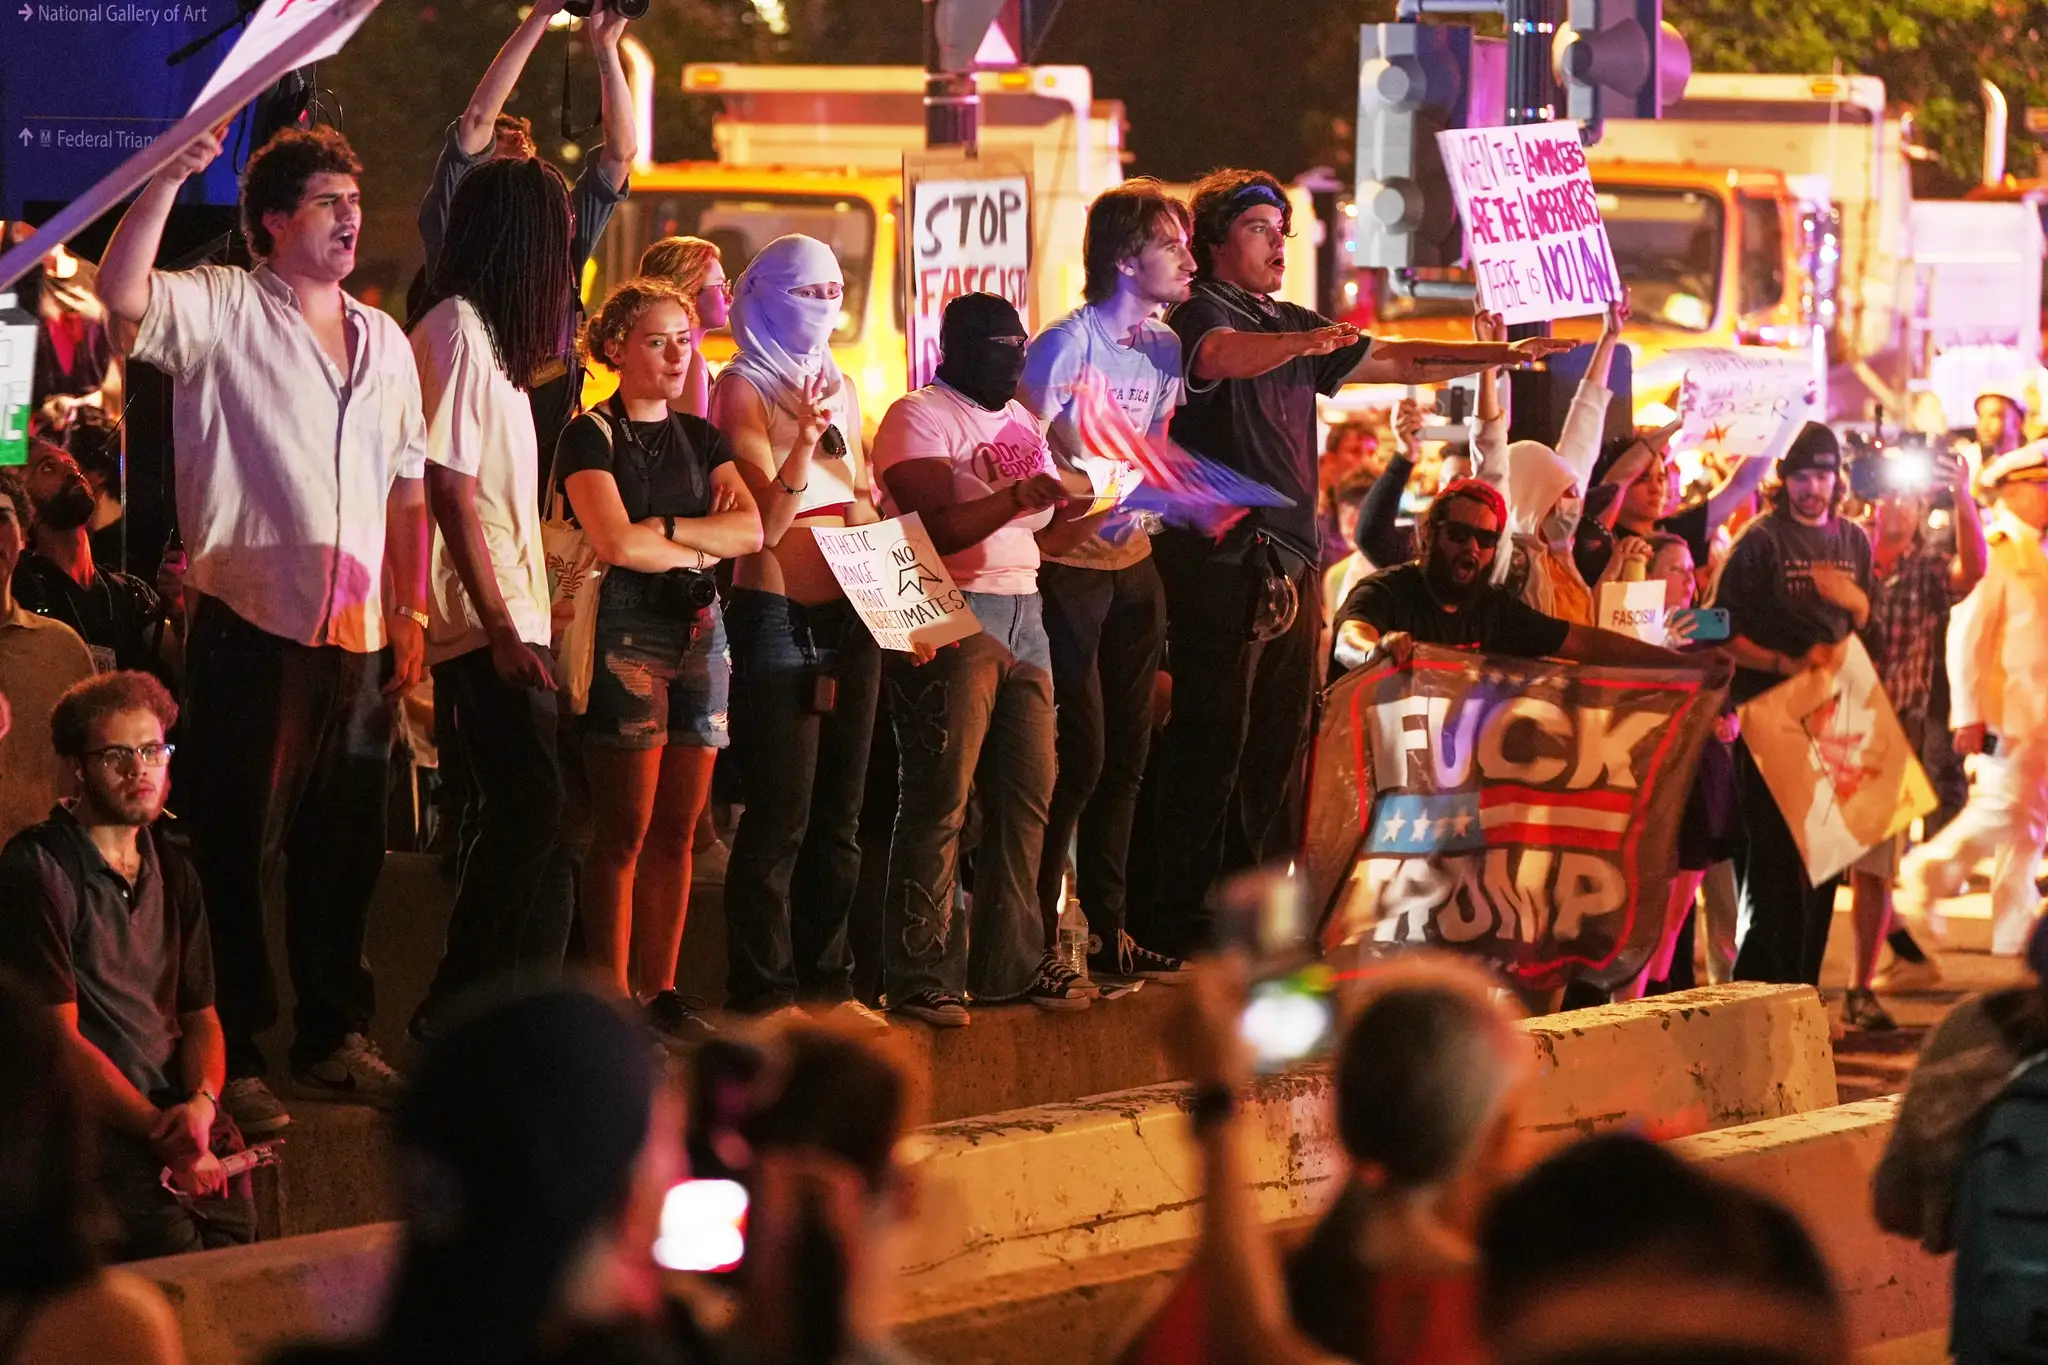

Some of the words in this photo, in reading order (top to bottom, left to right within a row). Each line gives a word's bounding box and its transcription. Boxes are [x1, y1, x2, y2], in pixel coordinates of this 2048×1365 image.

[38, 4, 102, 22] National
[106, 4, 159, 25] Gallery
[163, 4, 181, 22] of
[184, 5, 207, 22] Art
[57, 130, 112, 148] Federal
[1455, 134, 1499, 191] WHEN
[1493, 142, 1521, 177] THE
[920, 189, 1022, 258] STOP
[1469, 196, 1500, 244] ARE
[1492, 197, 1525, 242] THE
[1479, 259, 1527, 309] THERE
[1526, 267, 1541, 296] IS
[1537, 244, 1574, 304] NO
[1567, 228, 1615, 303] LAW
[1129, 388, 1150, 403] RICA
[994, 442, 1021, 462] Dr
[812, 529, 876, 556] PATHETIC
[892, 546, 916, 566] NO
[831, 560, 879, 586] ORANGE
[846, 587, 889, 610] TYRANT
[872, 630, 910, 649] SOCIET
[1366, 694, 1672, 792] FUCK
[1334, 848, 1627, 945] TRUMP
